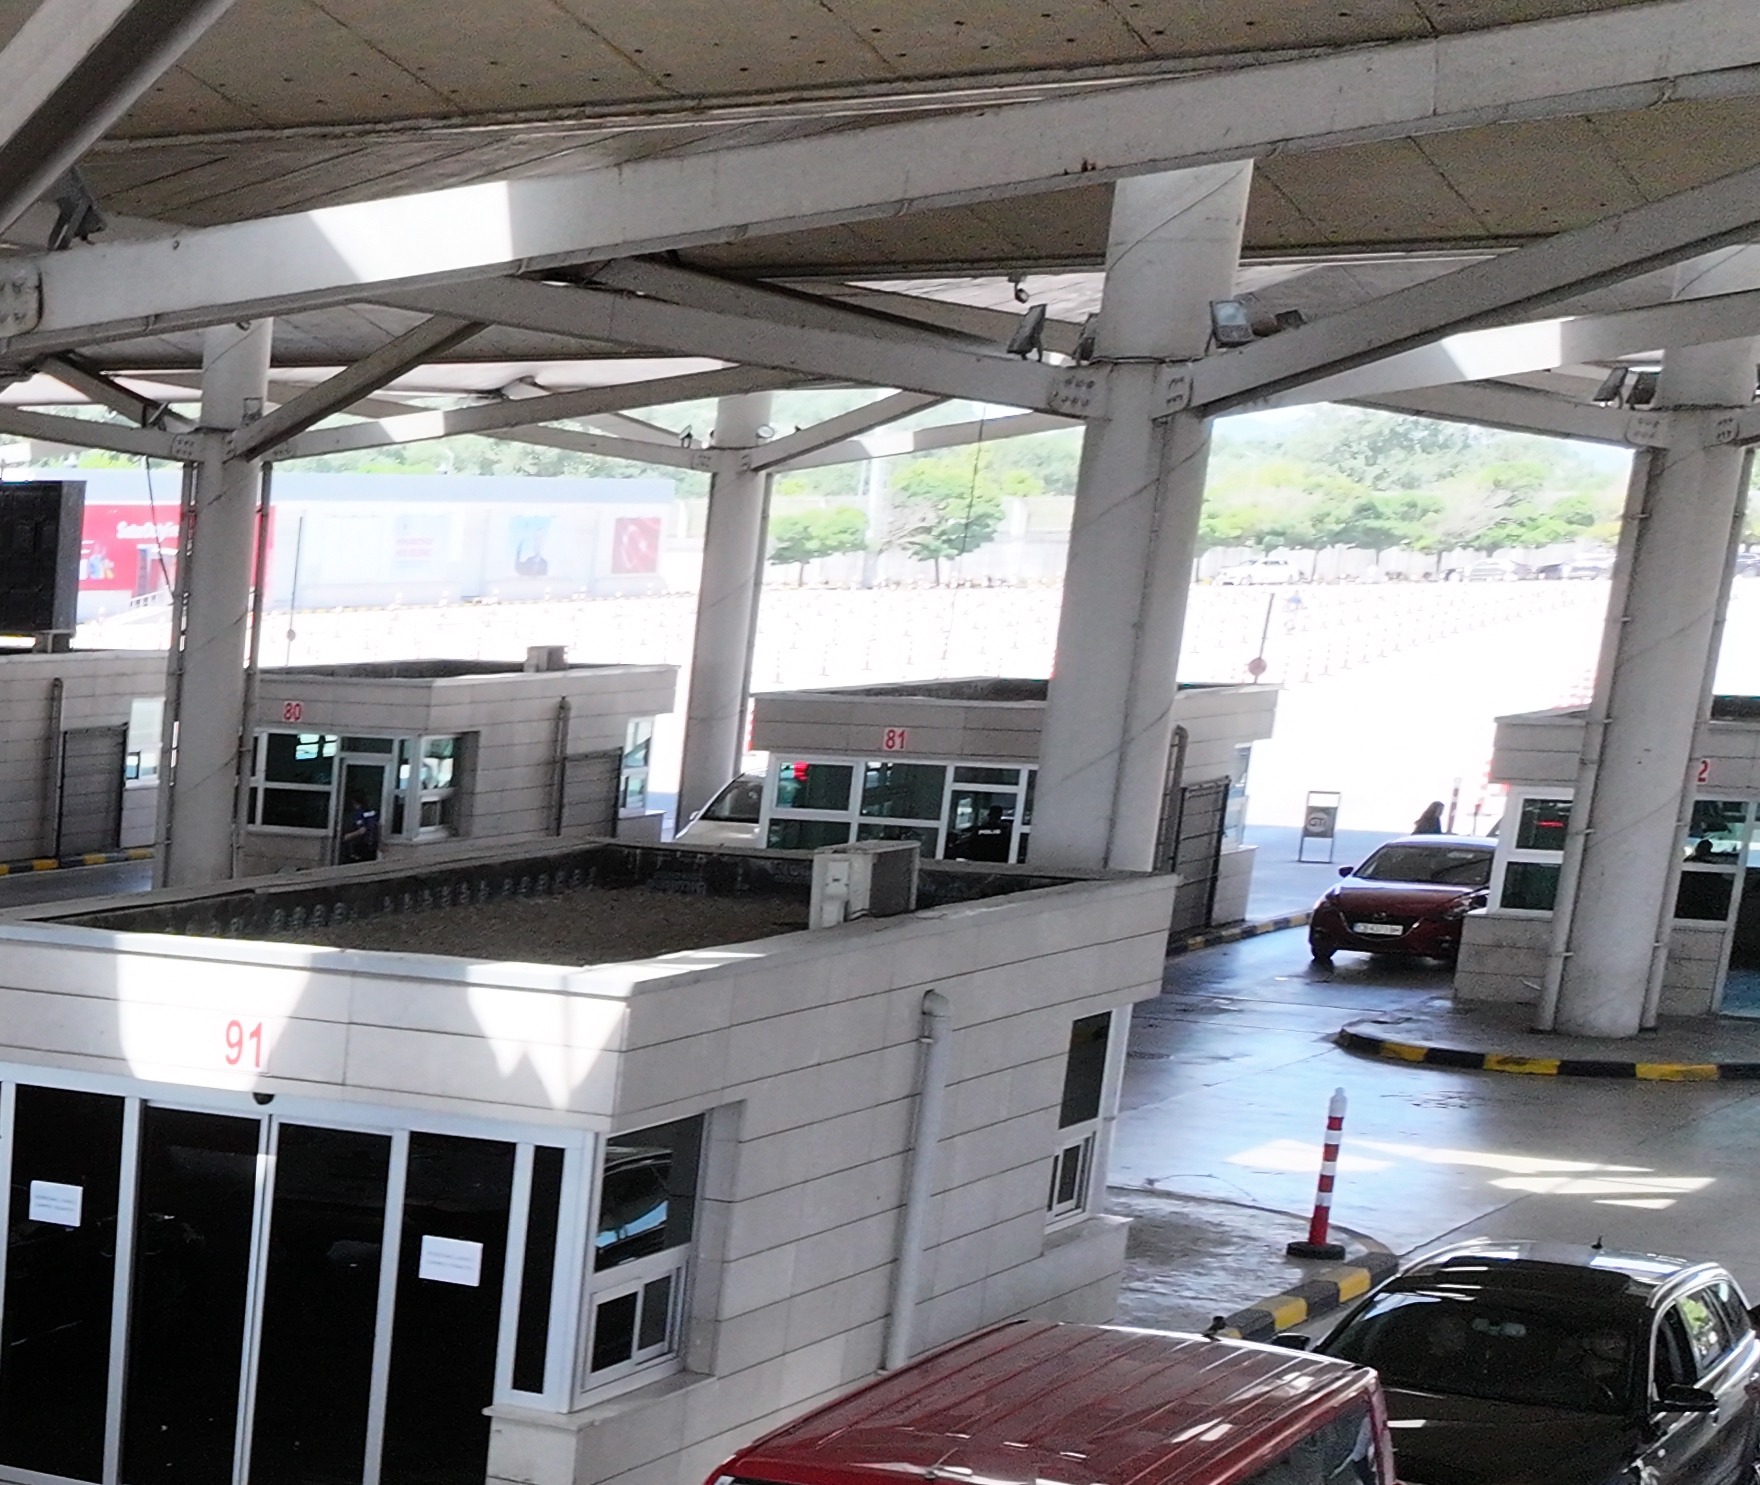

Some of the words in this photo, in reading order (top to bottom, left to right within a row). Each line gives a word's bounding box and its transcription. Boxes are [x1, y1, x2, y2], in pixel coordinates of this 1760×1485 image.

[283, 702, 301, 721] 80
[885, 729, 906, 750] 81
[1697, 759, 1709, 783] 2
[226, 1019, 263, 1068] 91
